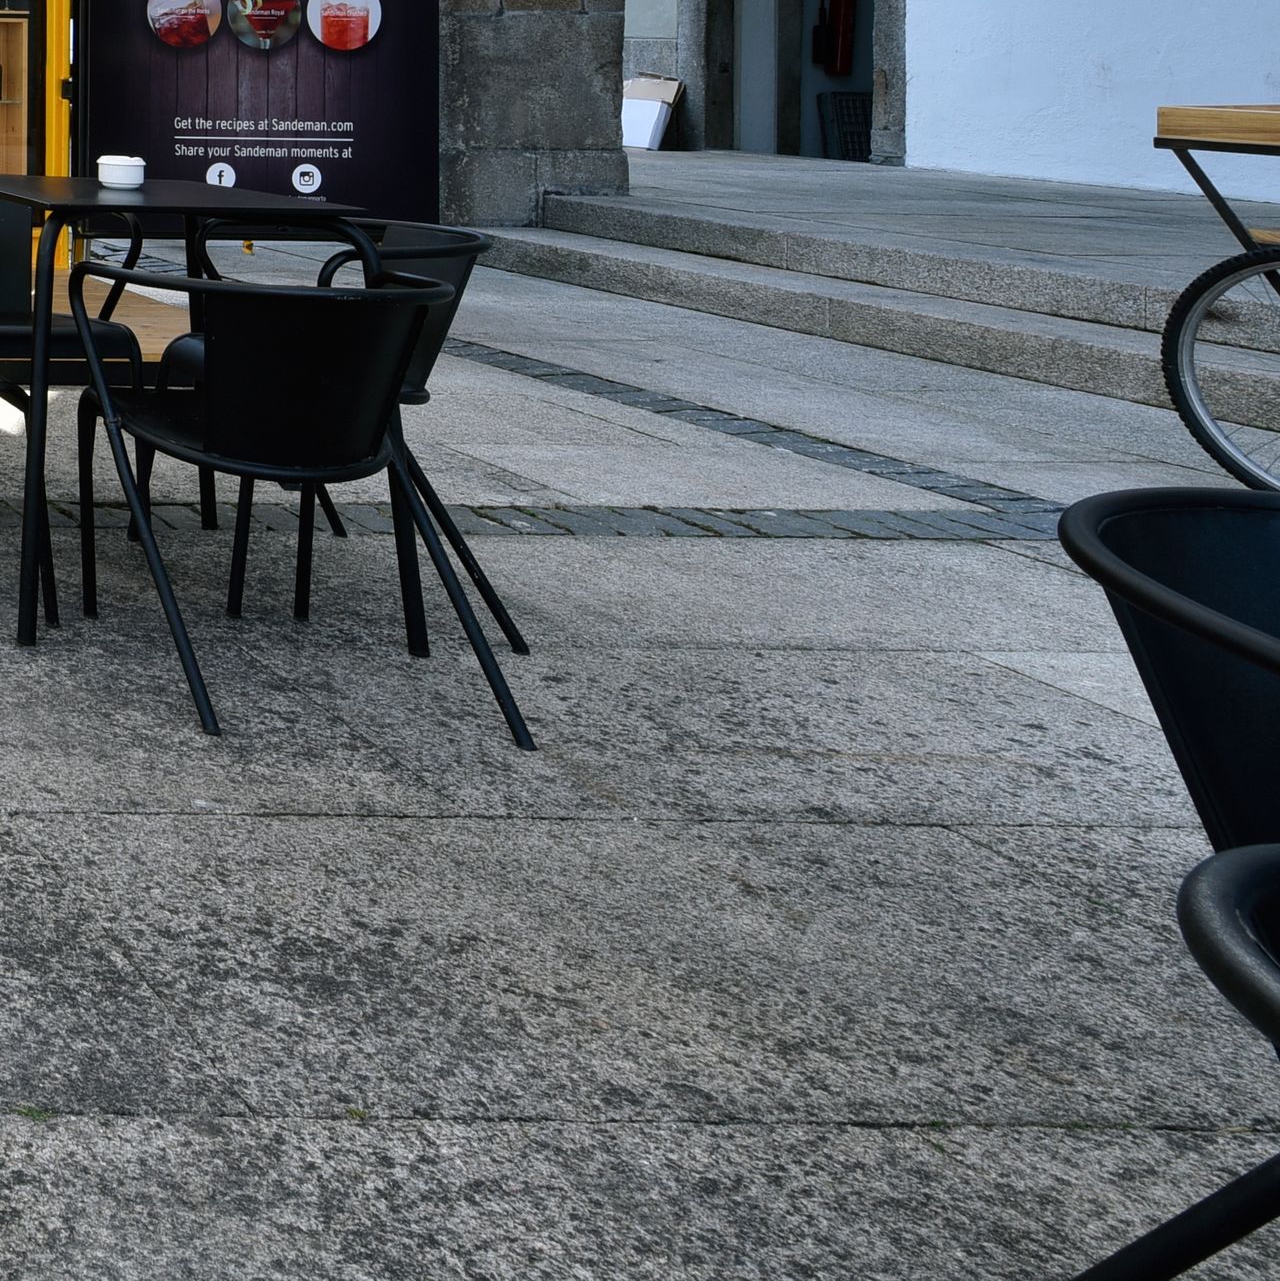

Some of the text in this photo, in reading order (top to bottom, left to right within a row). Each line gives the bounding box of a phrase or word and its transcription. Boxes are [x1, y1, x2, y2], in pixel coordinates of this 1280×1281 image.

[174, 117, 354, 133] Get the recipes at Sandeman.com
[174, 144, 353, 159] Share your Sandeman moments at
